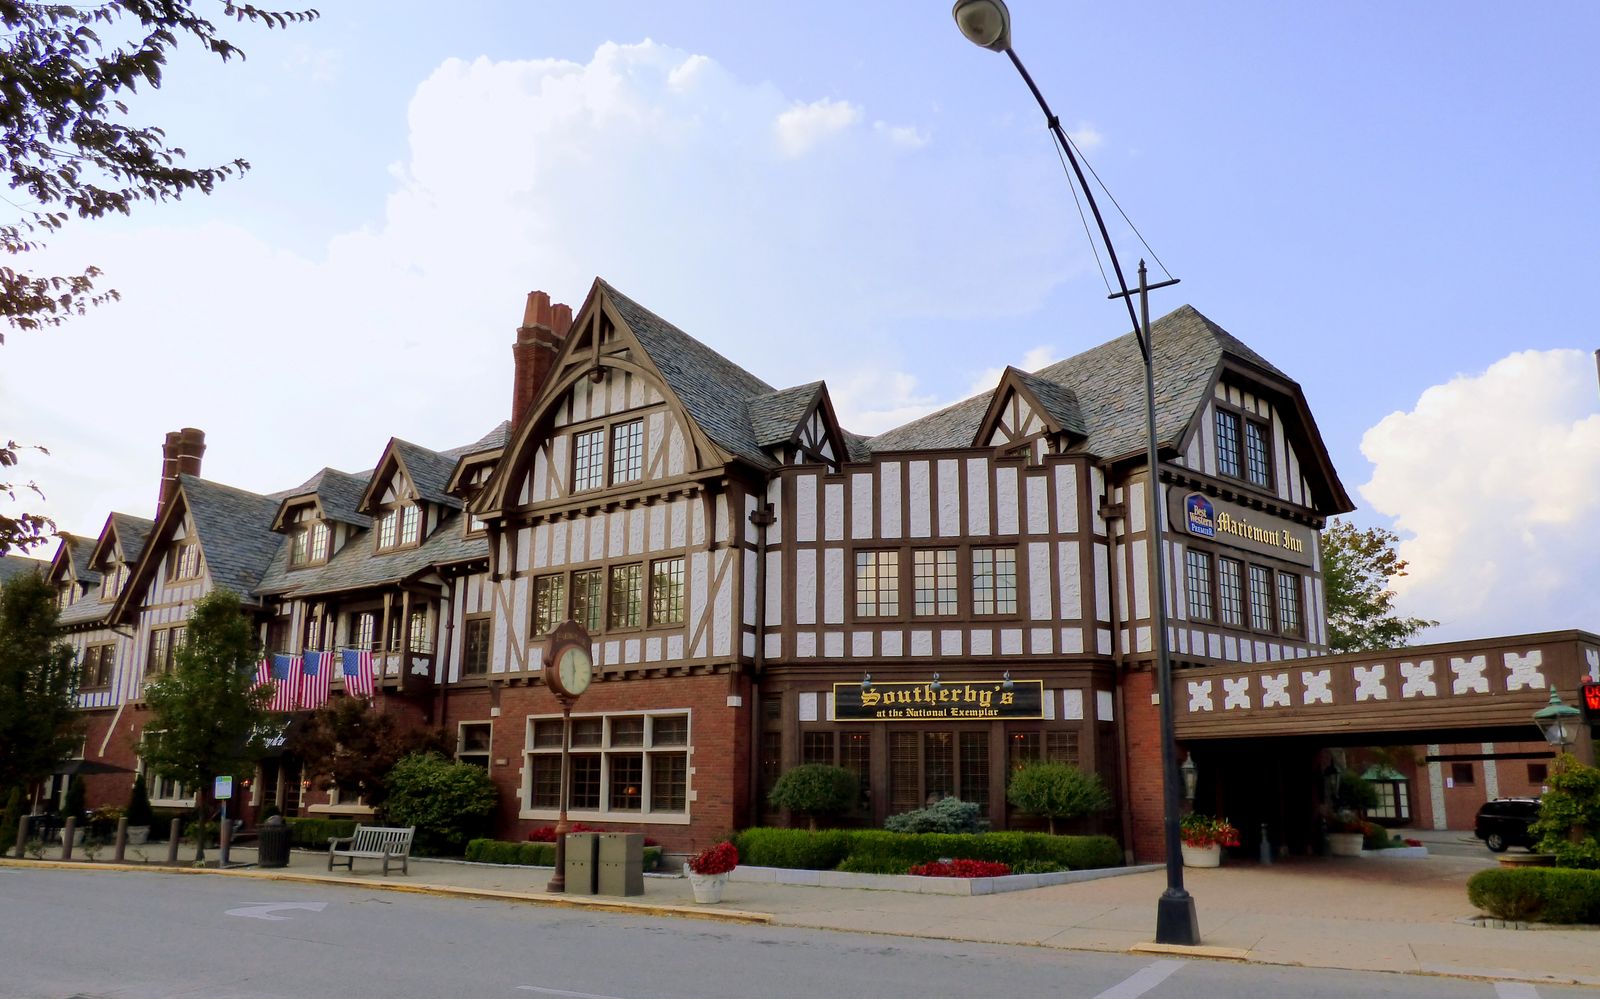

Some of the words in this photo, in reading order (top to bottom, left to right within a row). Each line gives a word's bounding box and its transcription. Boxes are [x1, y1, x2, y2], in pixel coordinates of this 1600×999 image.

[1217, 511, 1280, 547] Mariemont
[1282, 529, 1303, 553] Inn
[861, 684, 1014, 708] Southerby's
[876, 709, 886, 718] at
[888, 708, 903, 718] the
[905, 707, 948, 718] National
[950, 707, 999, 718] Exemplar
